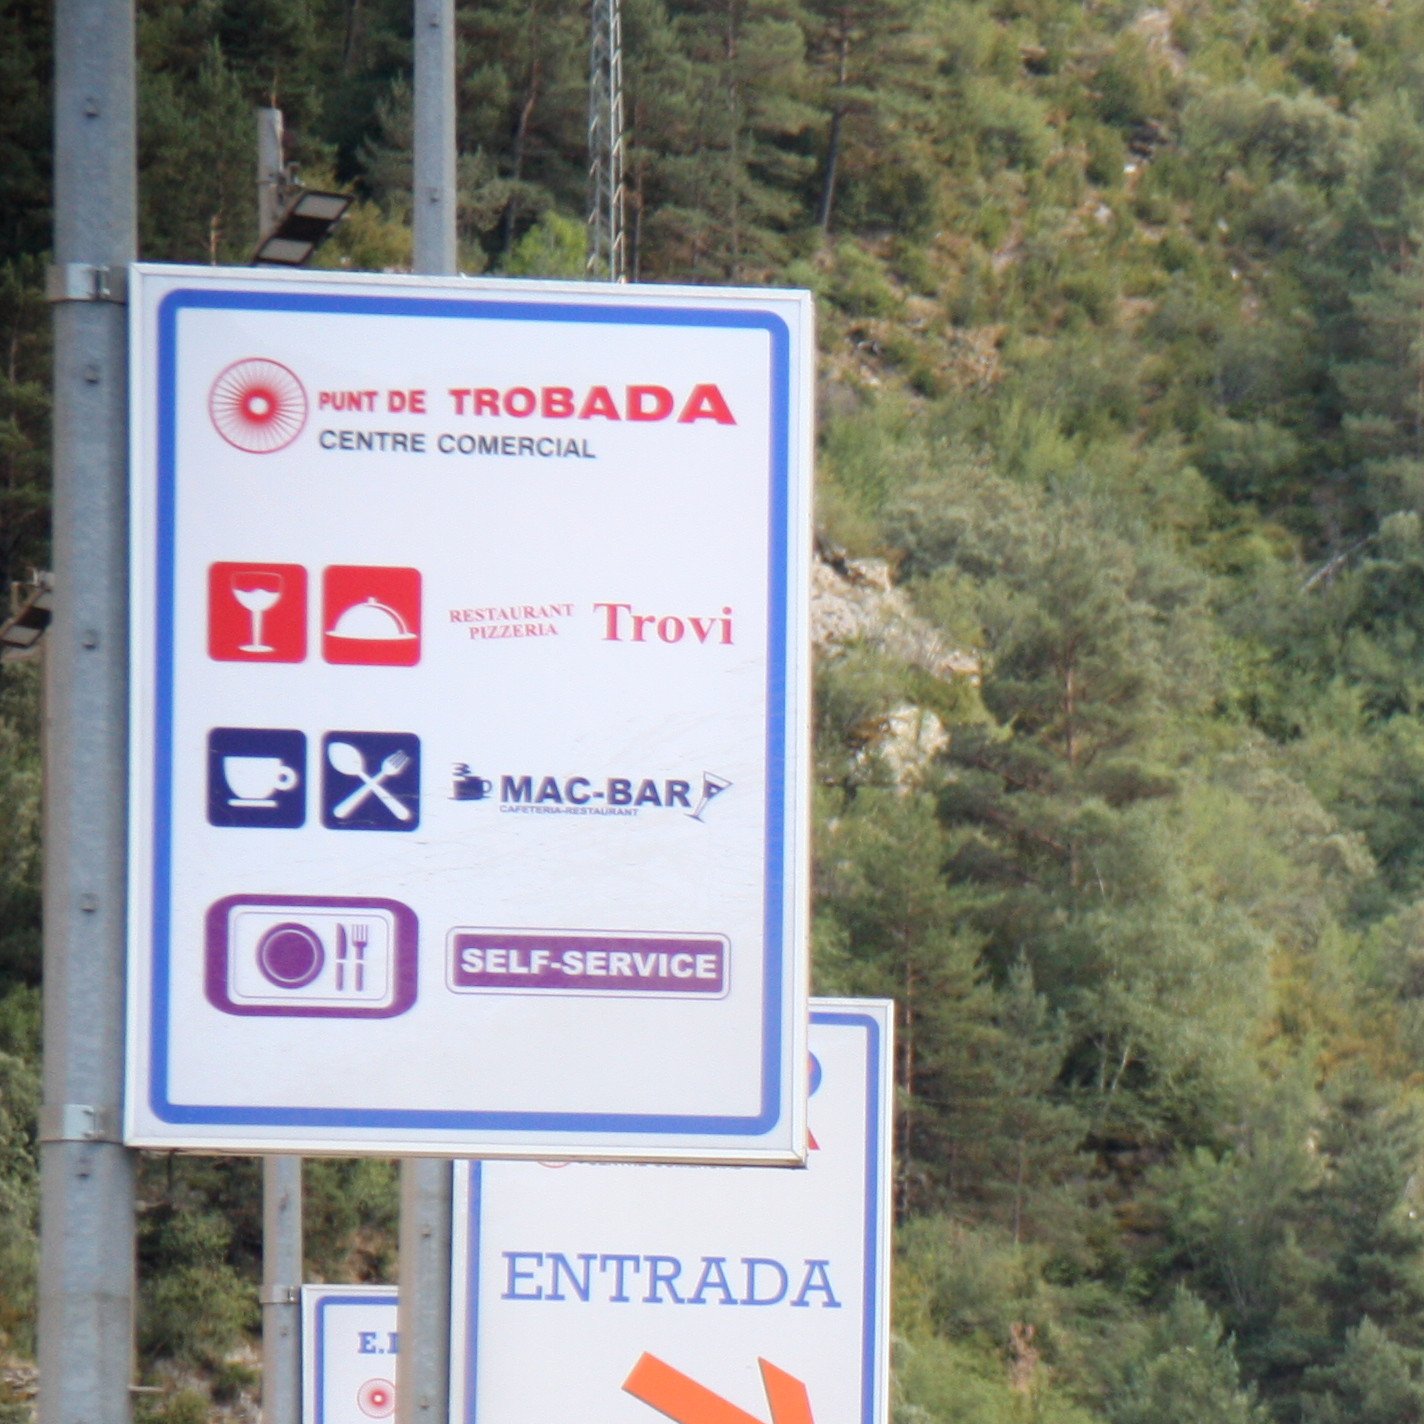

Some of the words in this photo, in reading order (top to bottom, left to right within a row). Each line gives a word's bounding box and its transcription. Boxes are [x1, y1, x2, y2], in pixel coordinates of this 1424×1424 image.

[318, 390, 378, 411] PUNT
[388, 389, 427, 414] DE
[448, 383, 737, 425] TROBADA
[318, 429, 426, 453] CENTRE
[437, 432, 596, 459] COMERCIAL
[449, 603, 574, 623] RESTAURANT
[593, 602, 735, 645] Trovi
[469, 623, 558, 640] PIZZERIA
[500, 775, 692, 808] MAC-BAR
[461, 947, 718, 979] SELF-SERVICE
[500, 1251, 842, 1308] ENTRADA
